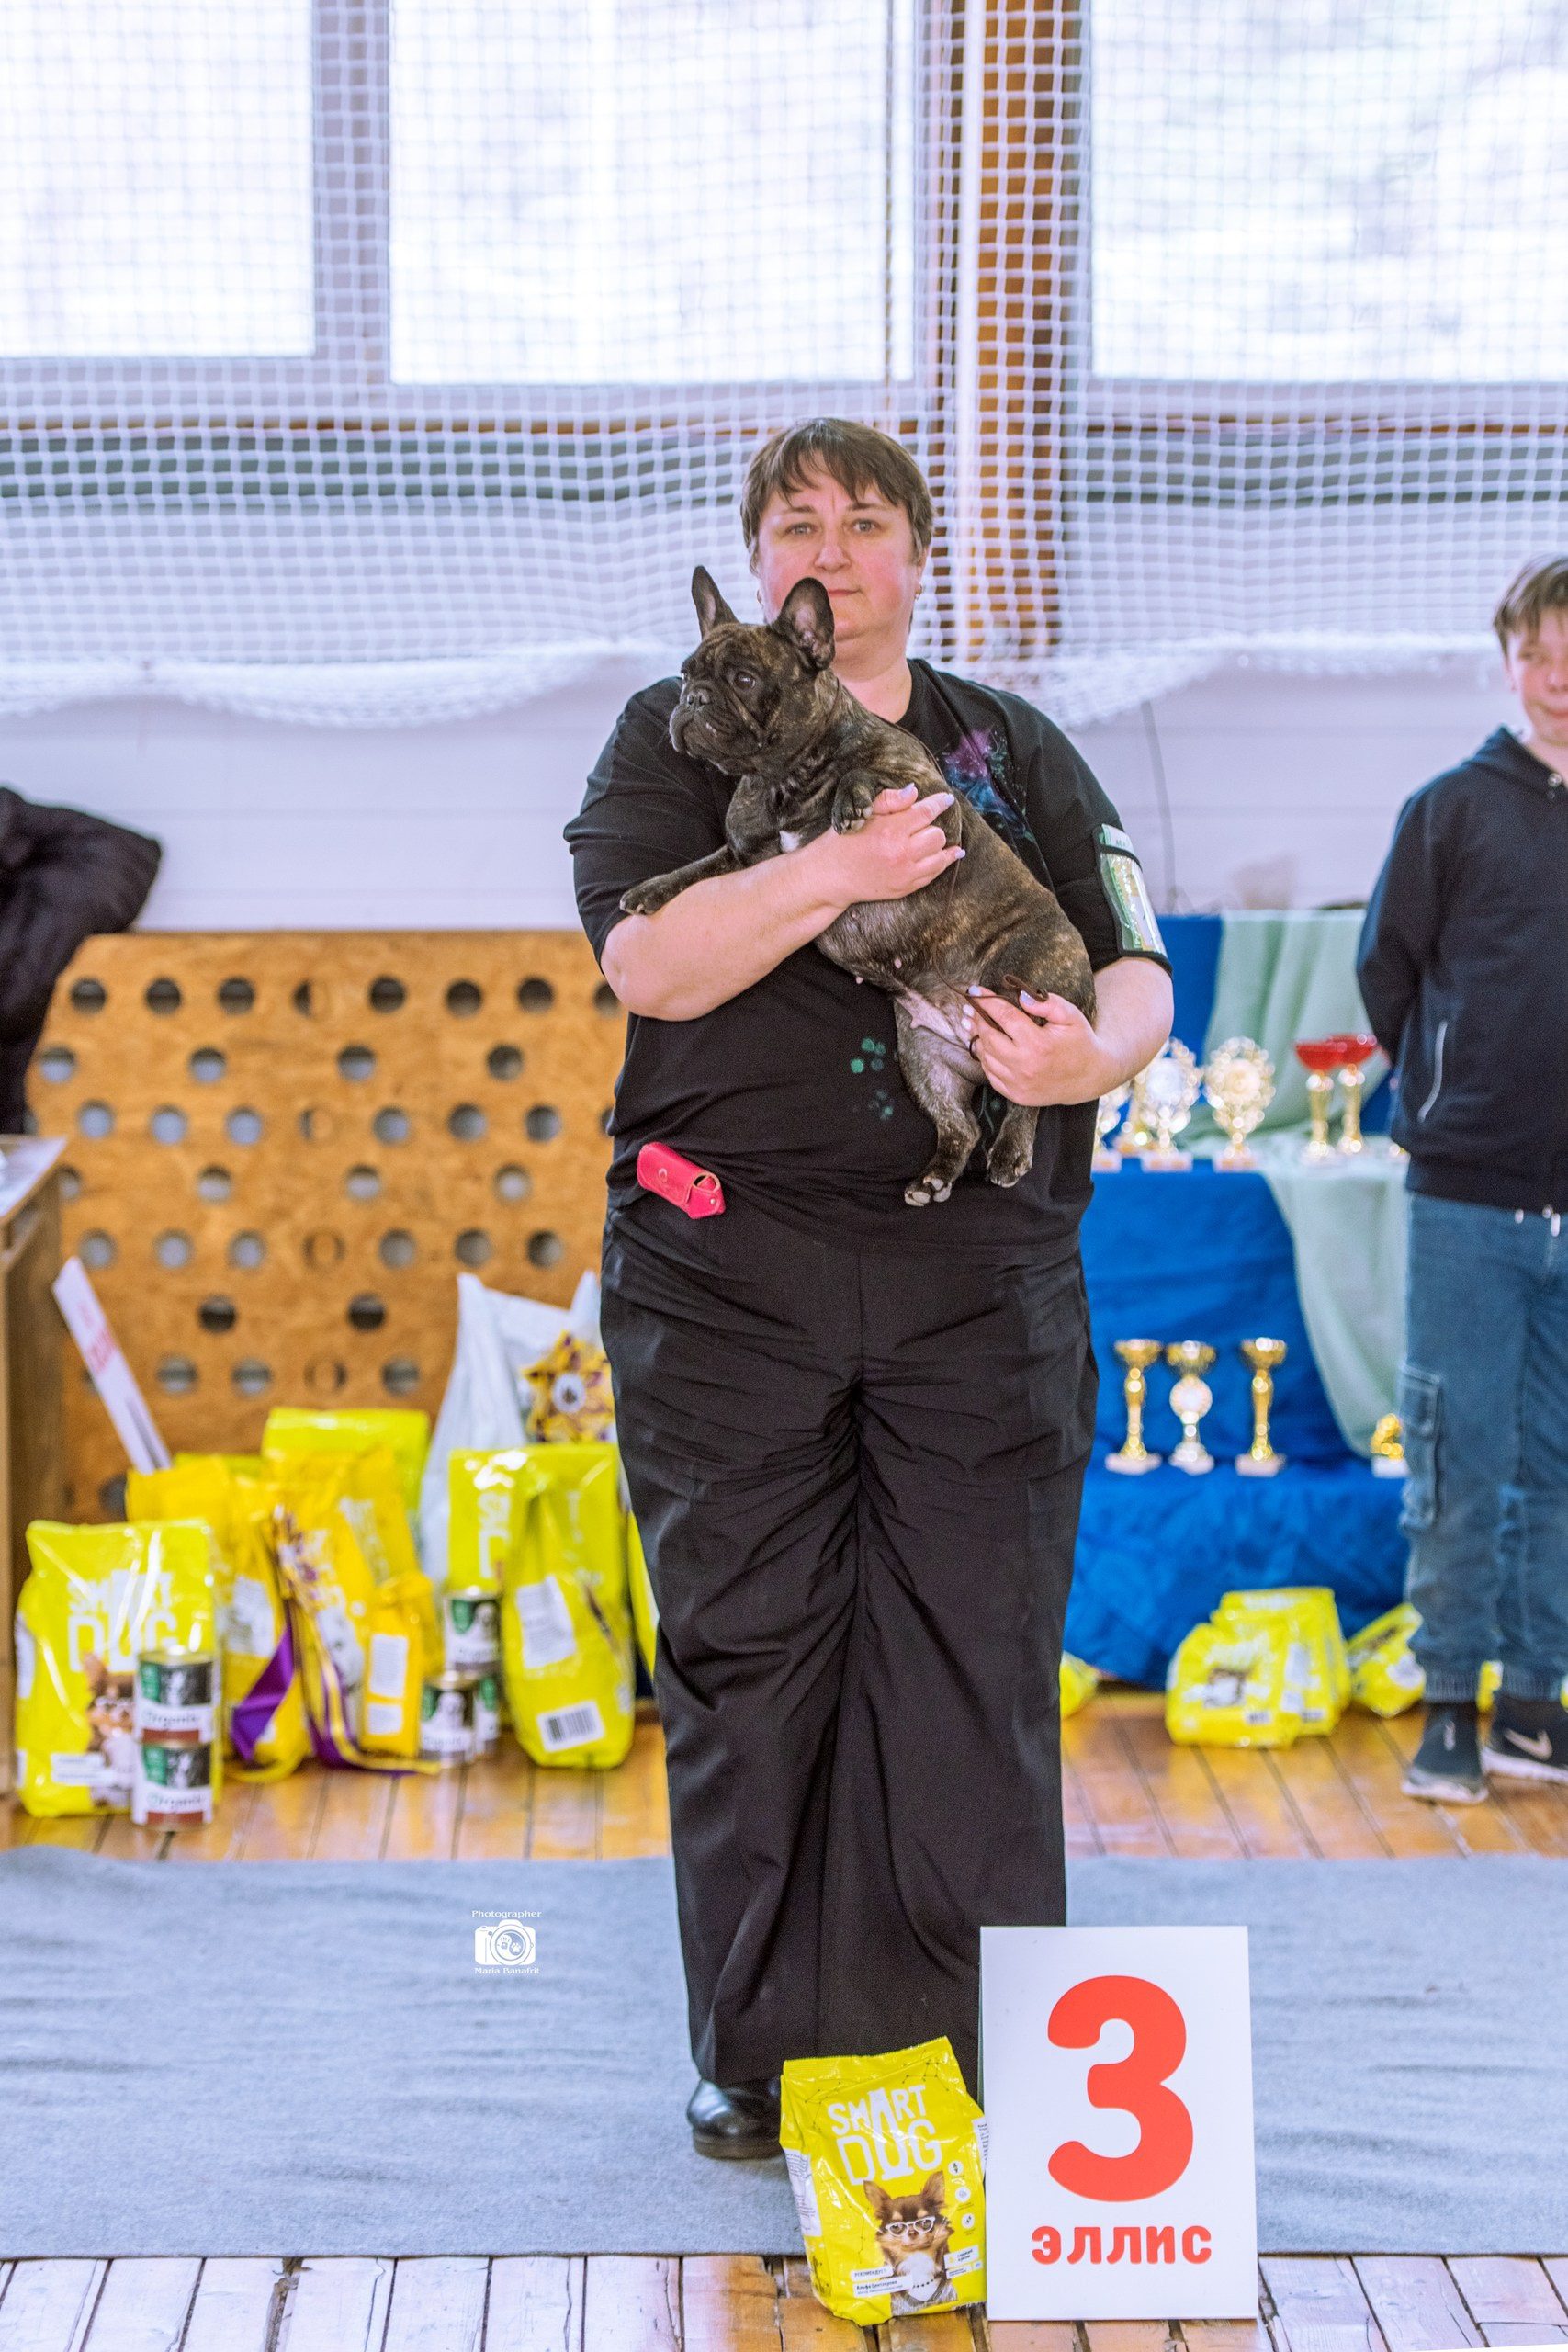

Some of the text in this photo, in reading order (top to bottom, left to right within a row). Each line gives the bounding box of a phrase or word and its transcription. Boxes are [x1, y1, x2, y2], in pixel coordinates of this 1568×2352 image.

[828, 2085, 926, 2136] SMART
[1047, 1974, 1194, 2202] 3
[836, 2119, 942, 2186] DOG
[1032, 2225, 1212, 2265] ЭЛЛИС
